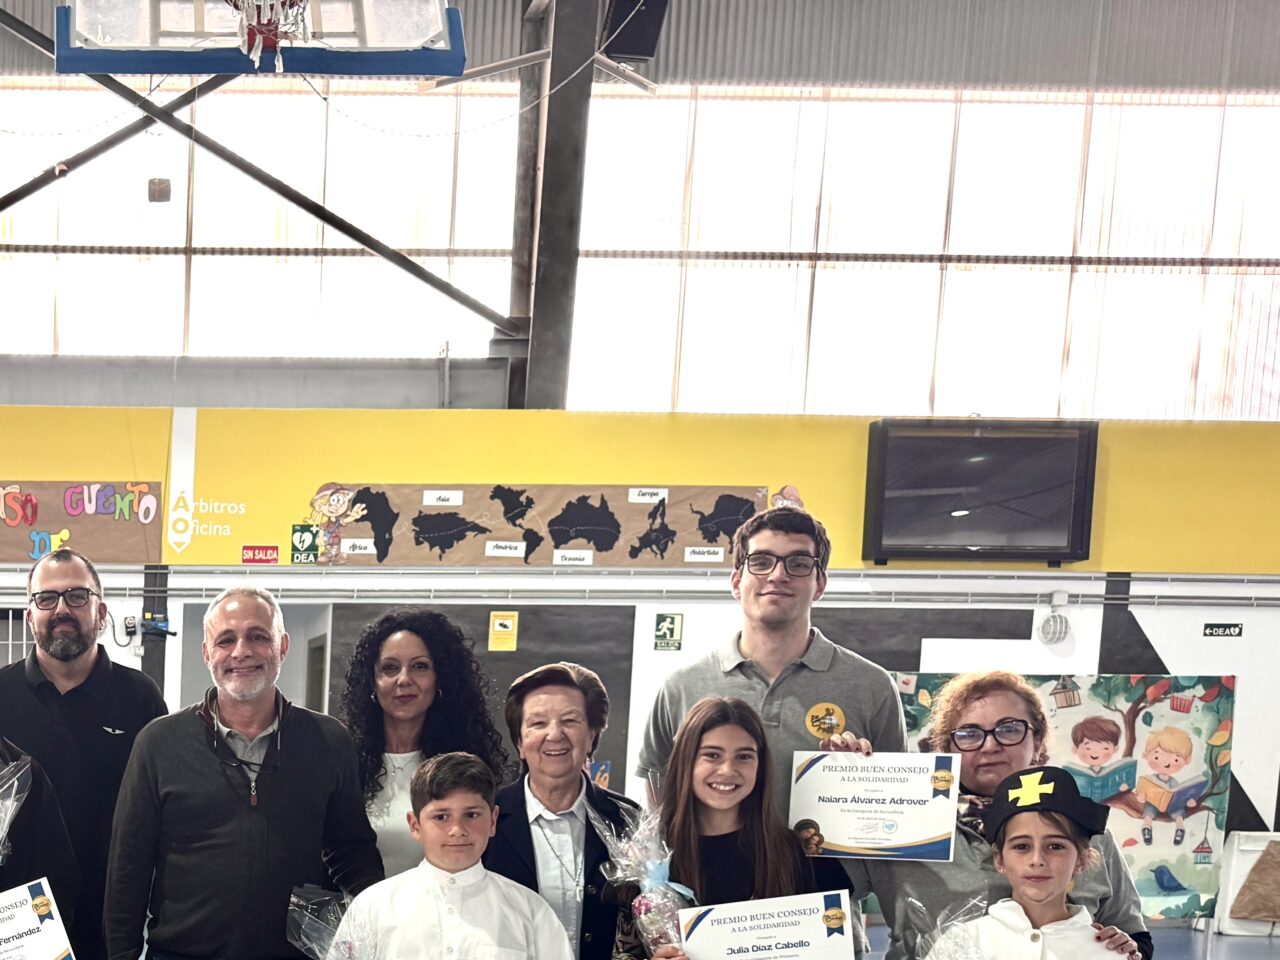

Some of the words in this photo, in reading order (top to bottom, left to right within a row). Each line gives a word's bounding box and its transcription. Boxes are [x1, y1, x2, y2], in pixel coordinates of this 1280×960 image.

[64, 482, 157, 524] CUENTO
[172, 490, 246, 514] Árbitros
[172, 518, 231, 536] Oficina
[254, 550, 277, 559] SALIDA
[850, 794, 886, 805] Álvarez
[889, 797, 929, 805] Adrover
[711, 915, 747, 926] PREMIO
[750, 912, 775, 922] BUEN
[777, 907, 819, 918] CONSEJO
[749, 921, 801, 931] SOLIDARIDAD
[726, 946, 749, 955] Julia
[751, 944, 773, 952] Díaz
[775, 940, 810, 950] Cabello
